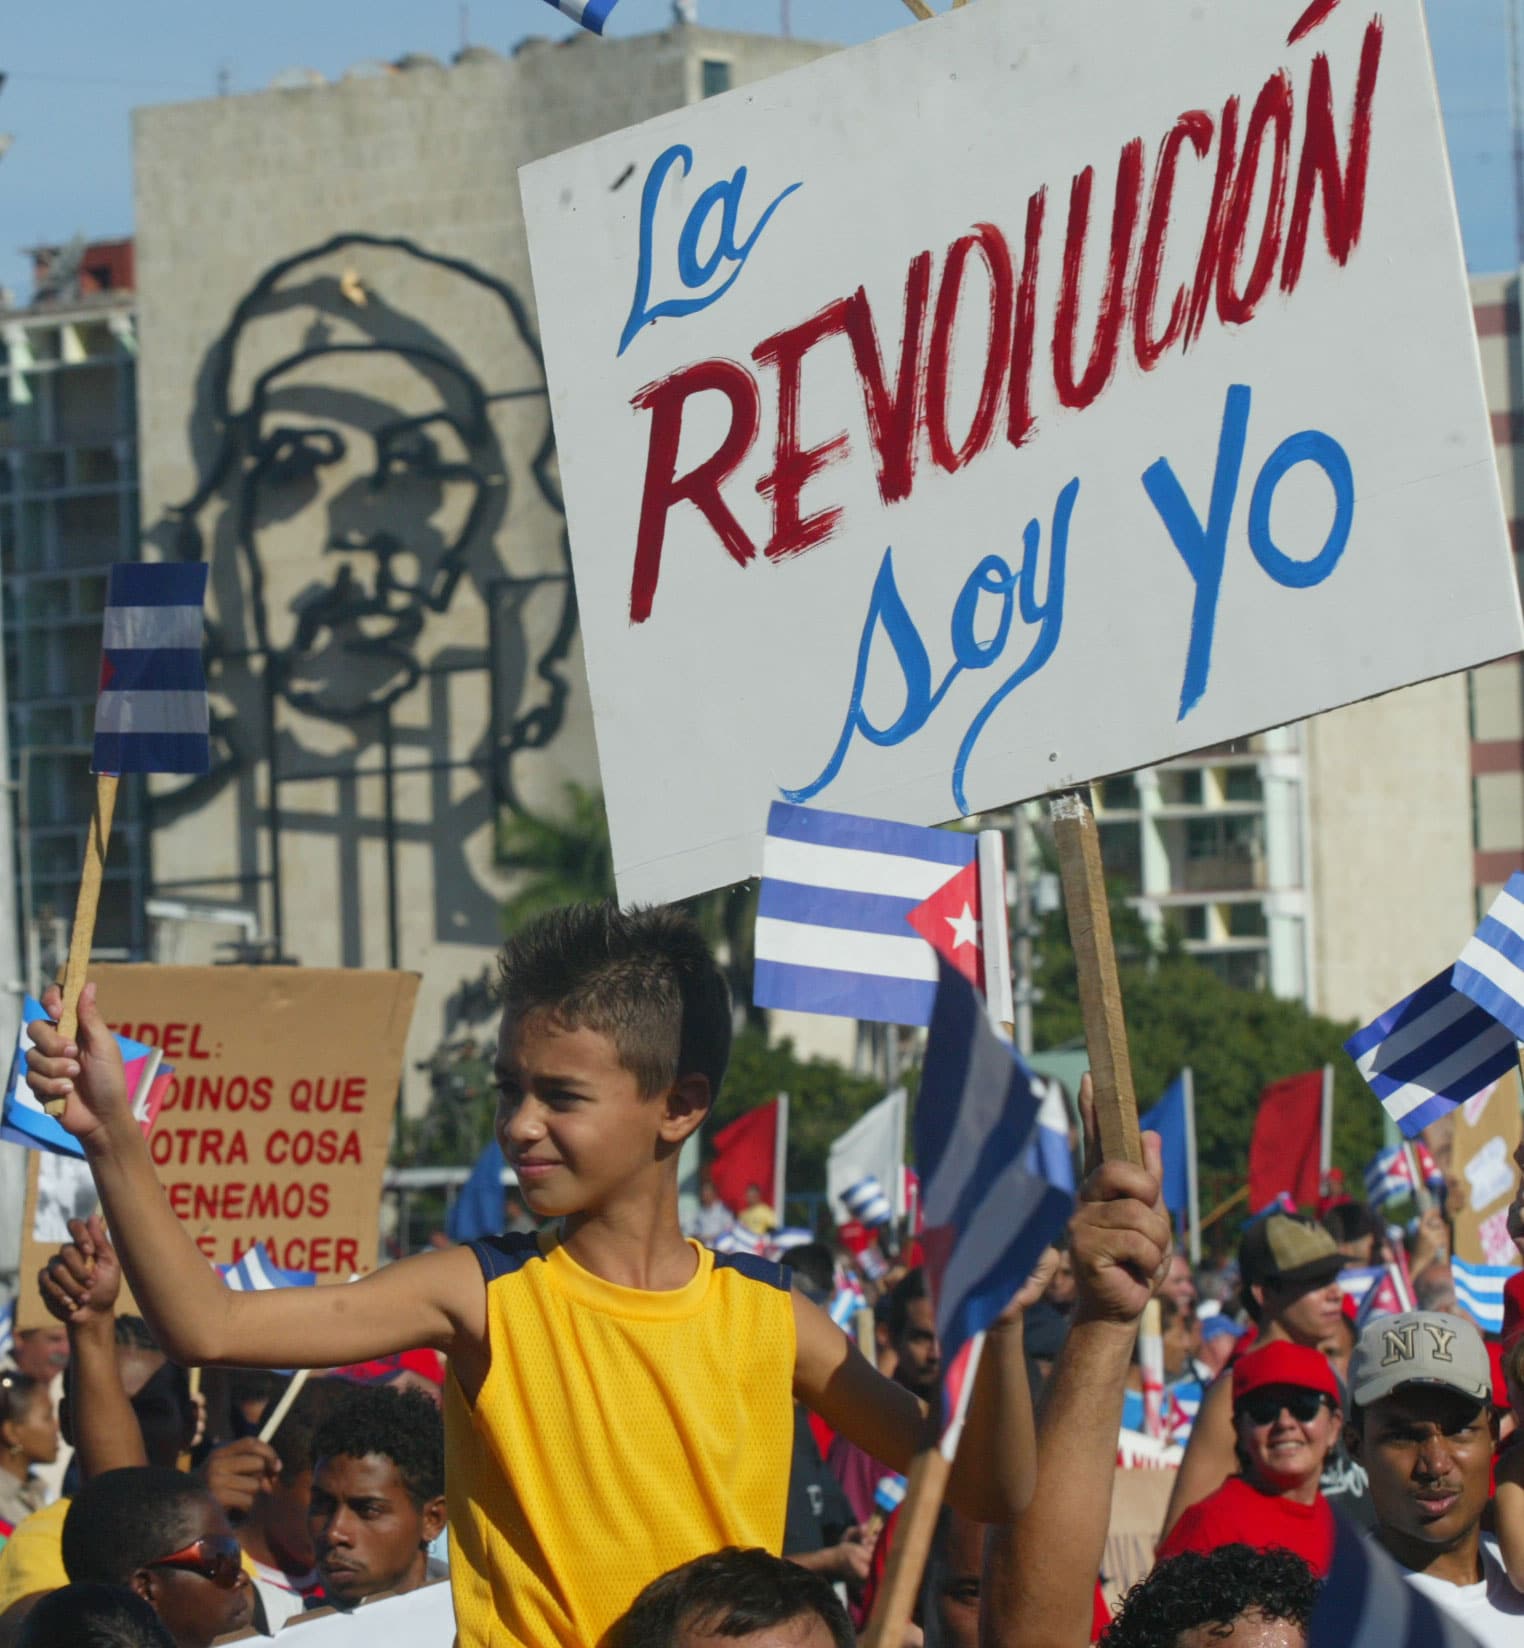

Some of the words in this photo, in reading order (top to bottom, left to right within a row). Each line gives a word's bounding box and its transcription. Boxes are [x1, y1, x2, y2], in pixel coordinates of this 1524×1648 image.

[617, 143, 802, 356] La
[290, 1076, 367, 1113] QUE
[150, 1128, 249, 1166] OTRA
[264, 1128, 363, 1166] COSA
[163, 1181, 330, 1220] ENEMOS
[1380, 1321, 1456, 1367] NY
